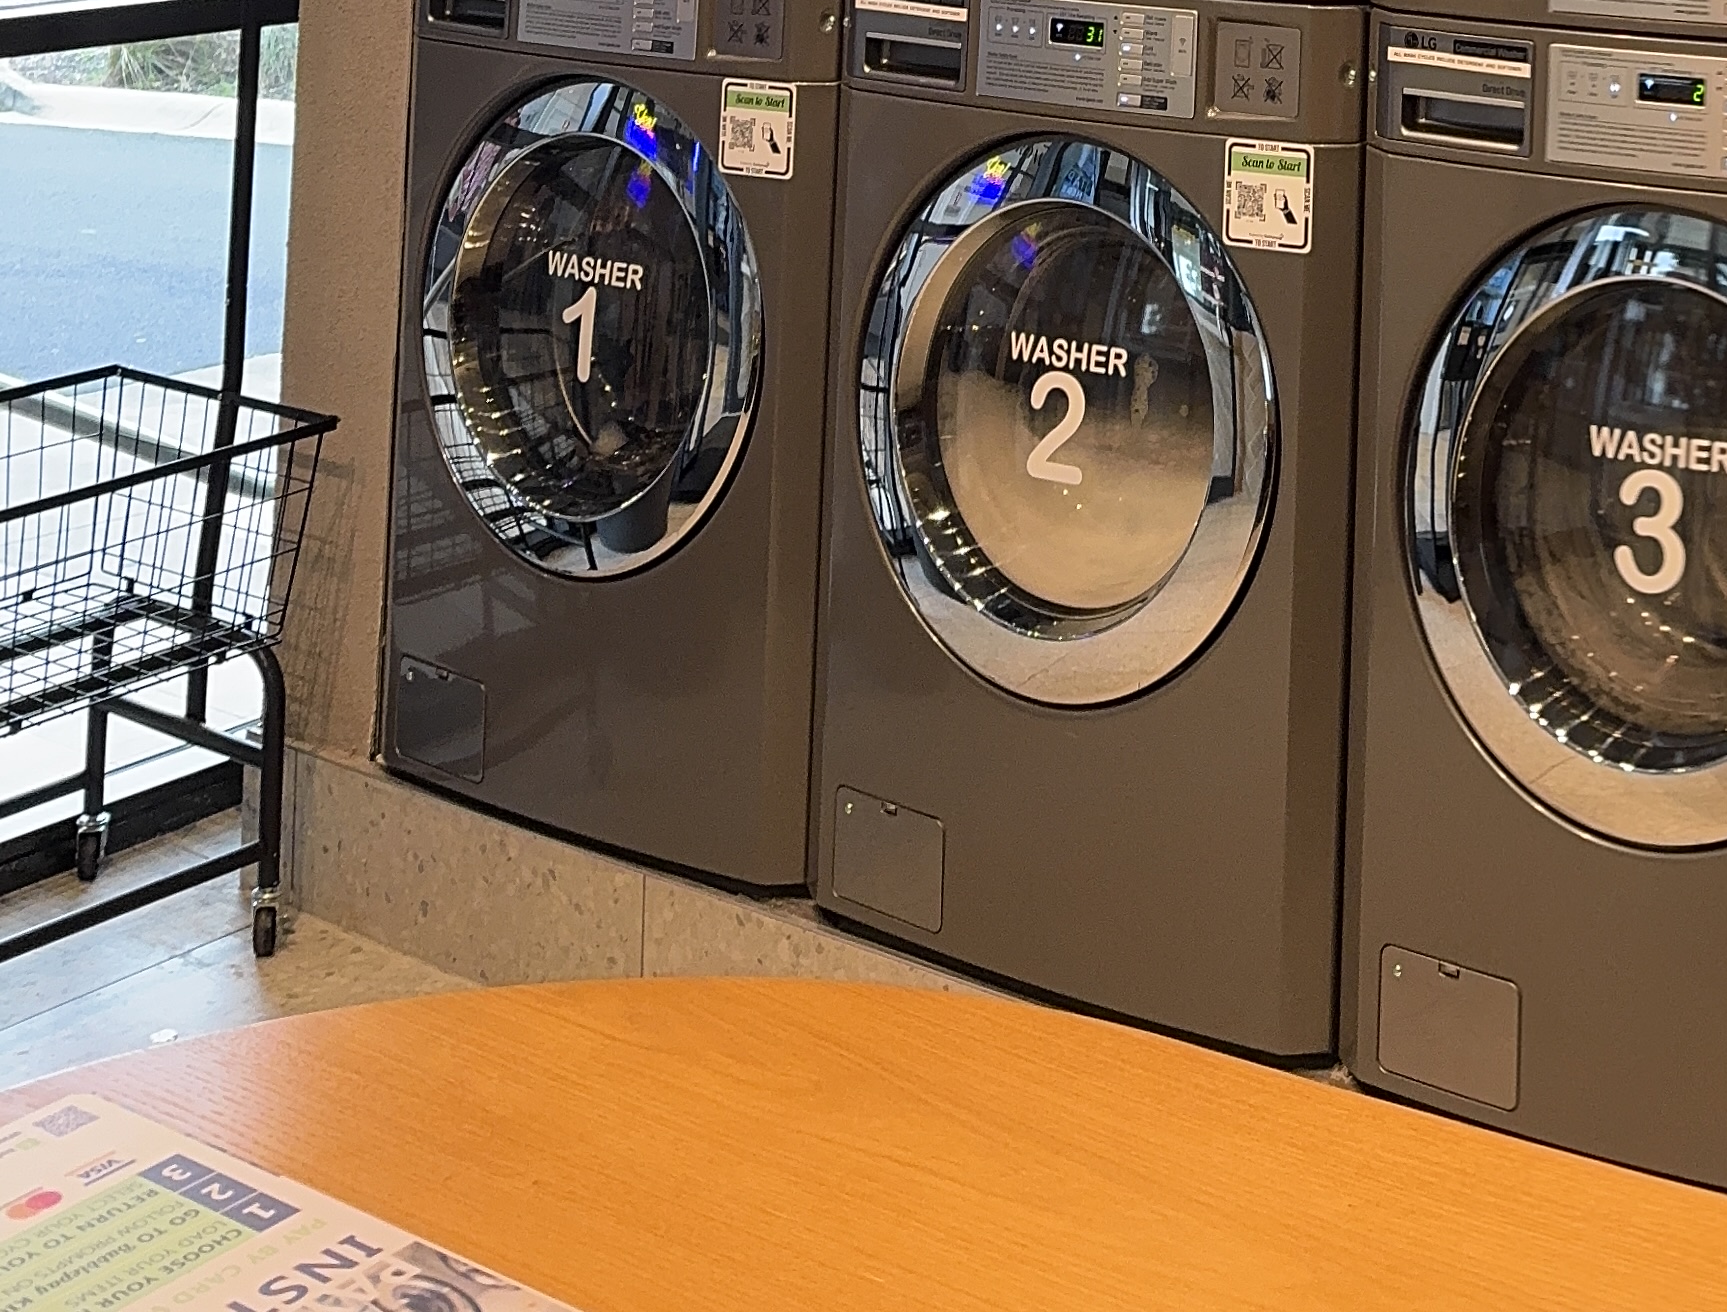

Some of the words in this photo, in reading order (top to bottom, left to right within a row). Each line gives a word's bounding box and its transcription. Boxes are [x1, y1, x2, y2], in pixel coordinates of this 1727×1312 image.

[1421, 36, 1437, 50] LG
[1242, 156, 1264, 169] Scan
[1266, 159, 1274, 169] to
[1278, 158, 1301, 172] Start
[548, 249, 643, 291] WASHER
[561, 288, 596, 383] 1
[1010, 330, 1128, 377] WASHER
[1026, 373, 1085, 485] 2
[1613, 470, 1686, 595] 3
[77, 1159, 125, 1179] VISA
[161, 1163, 192, 1181] 3
[200, 1182, 234, 1201] 2
[76, 1187, 160, 1232] RETURN
[169, 1208, 200, 1226] GO
[241, 1202, 276, 1220] 1
[42, 1232, 76, 1250] TO
[137, 1226, 168, 1244] TO
[178, 1221, 228, 1248] LOAD
[158, 1228, 243, 1275] CHOOSE
[95, 1275, 160, 1309] YOUR
